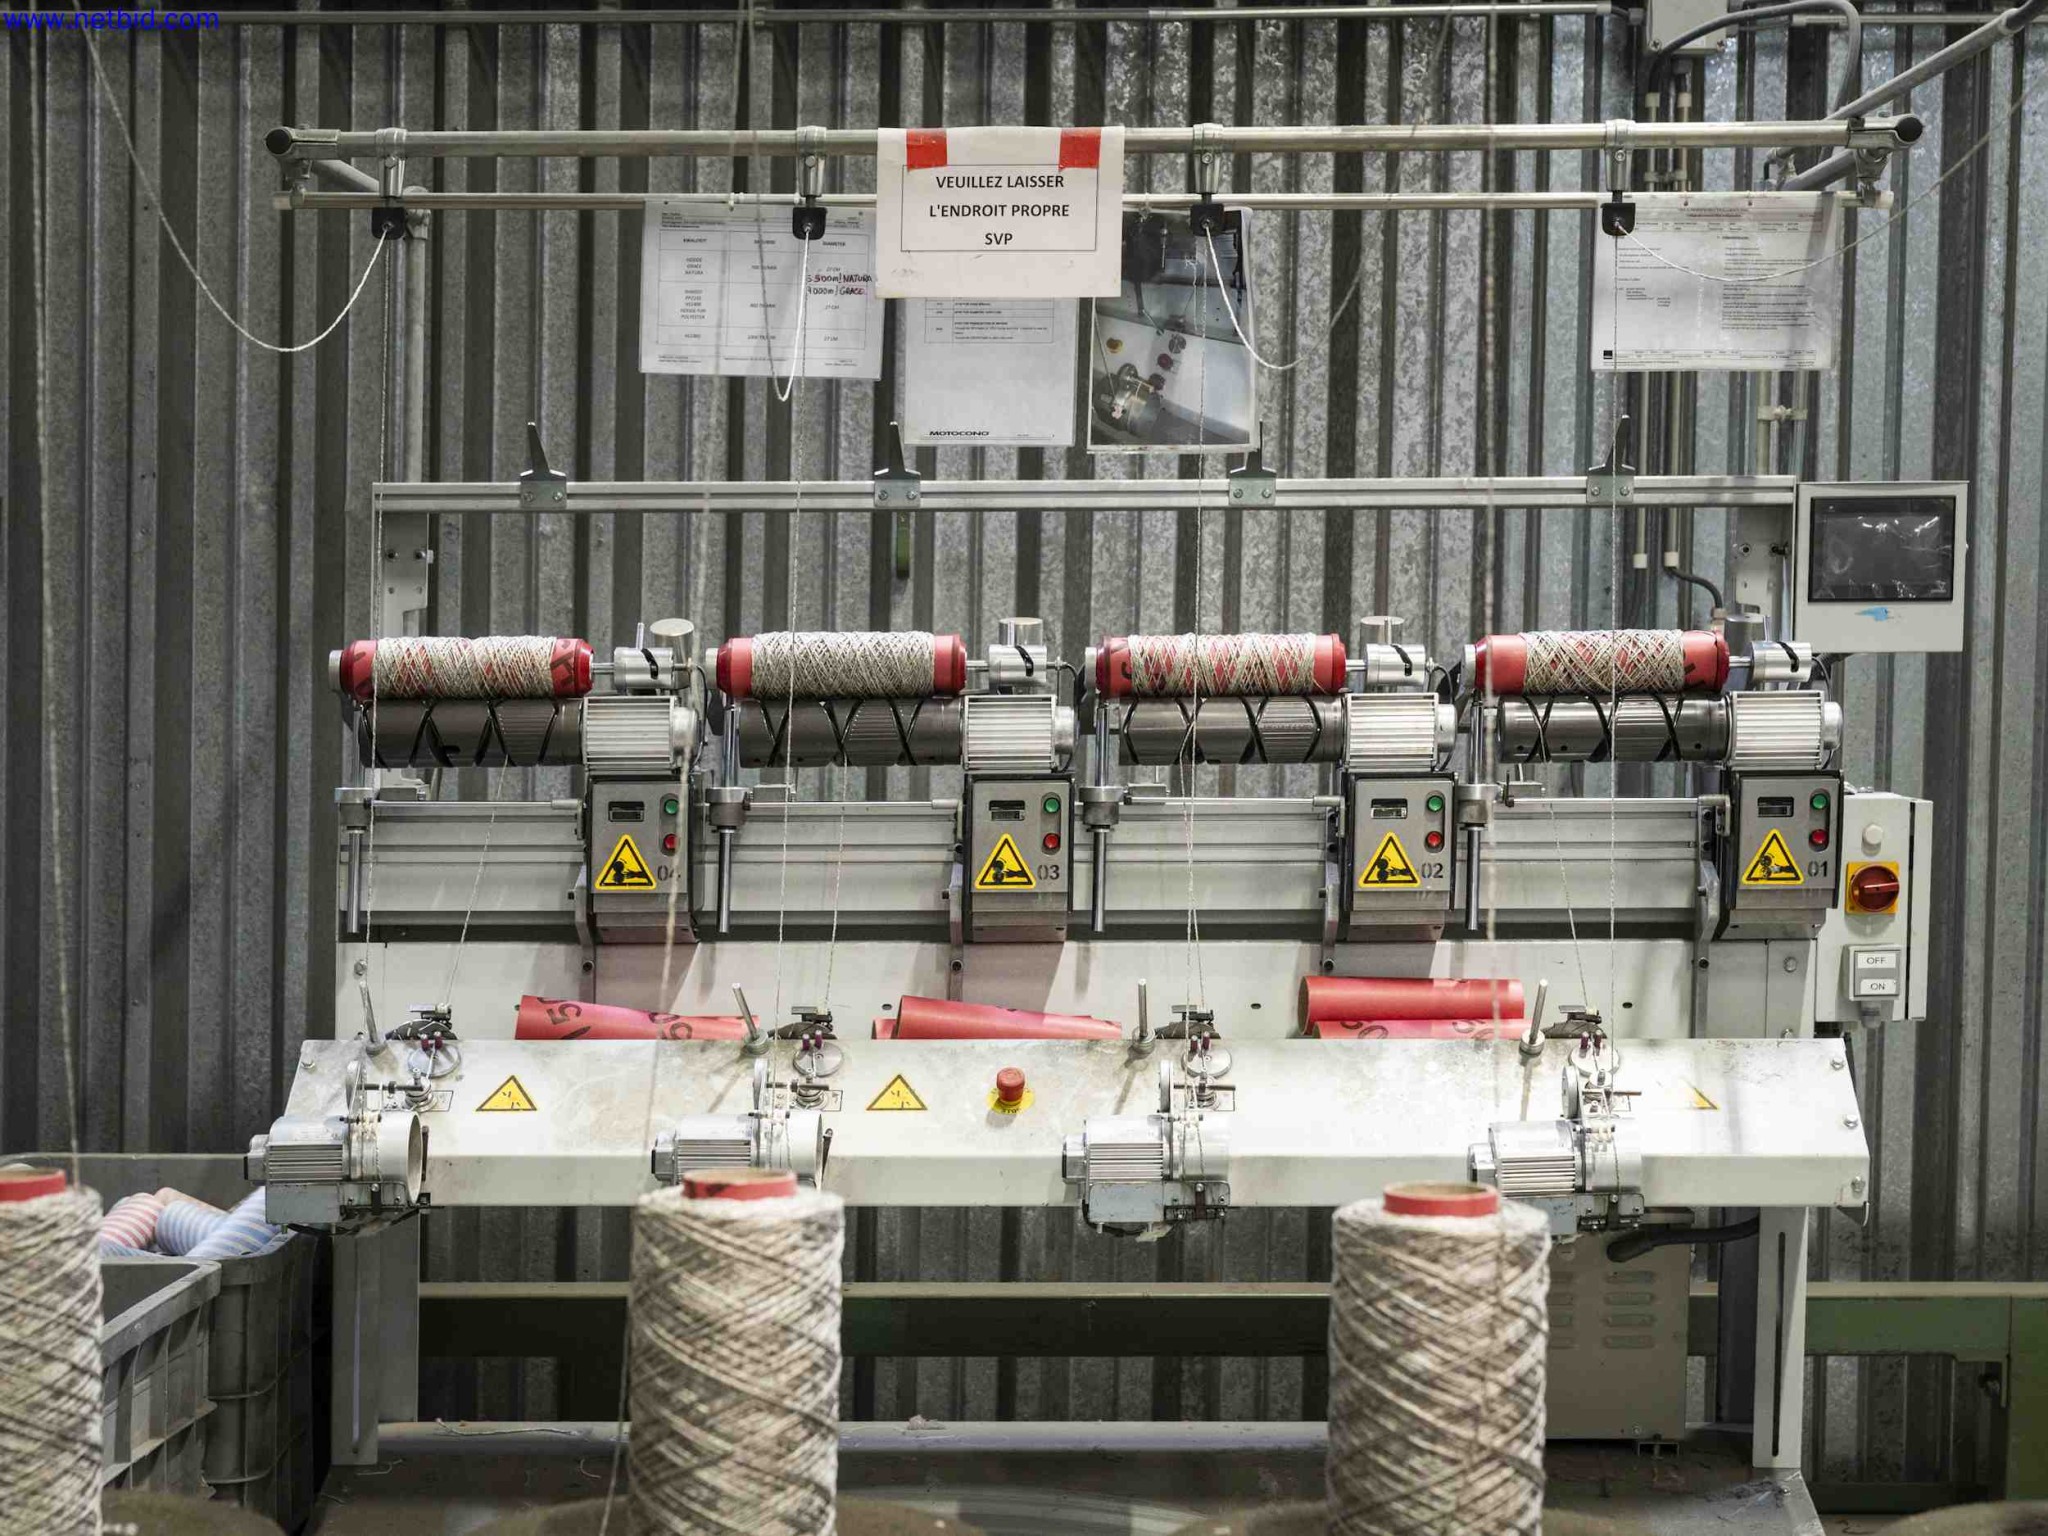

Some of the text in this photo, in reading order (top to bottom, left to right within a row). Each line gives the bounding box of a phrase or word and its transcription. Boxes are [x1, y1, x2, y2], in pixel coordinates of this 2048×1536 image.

[936, 175, 1065, 188] VEUILLEZ LAISSER
[929, 204, 1070, 217] L'ENDROIT PROPRE
[984, 233, 1013, 245] SVP
[1037, 864, 1060, 880] 03
[1421, 862, 1444, 878] 02
[1808, 860, 1828, 877] 01
[1866, 956, 1887, 965] OFF
[1870, 982, 1885, 991] ON
